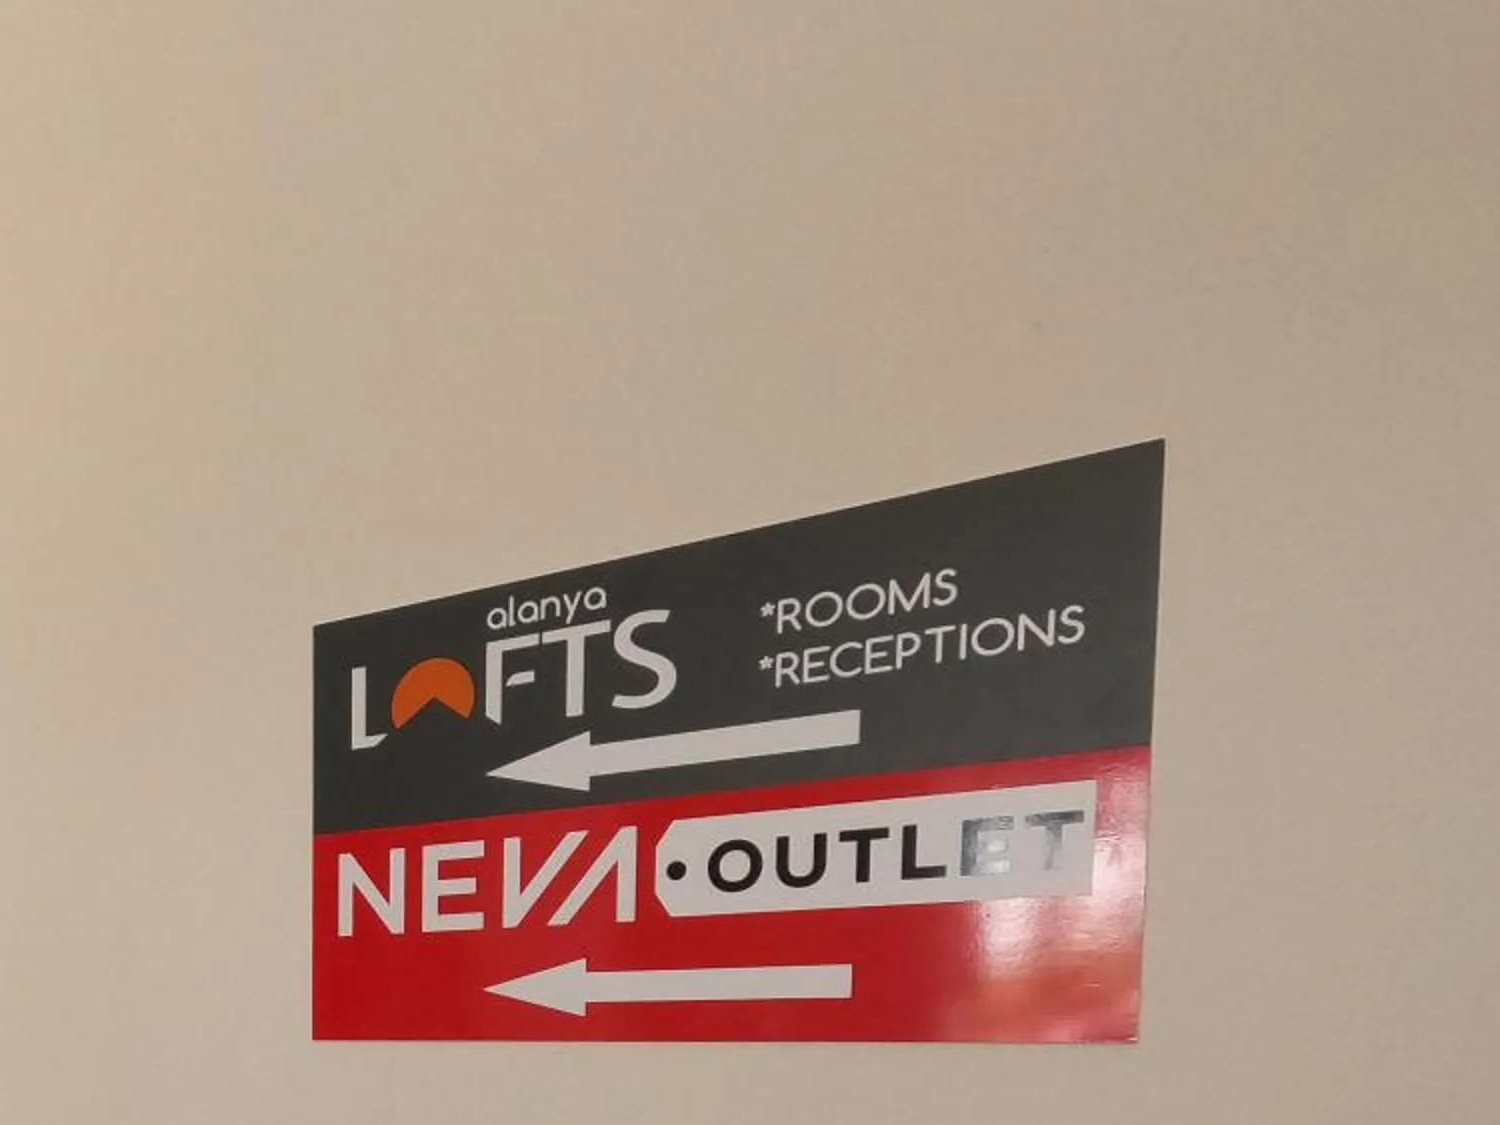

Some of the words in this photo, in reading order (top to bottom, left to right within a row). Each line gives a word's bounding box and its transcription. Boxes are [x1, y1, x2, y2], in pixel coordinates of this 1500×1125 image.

[487, 586, 607, 629] alanya
[351, 609, 678, 750] LOFTS
[337, 826, 637, 937] NEVA
[707, 810, 1085, 894] OUTLET
